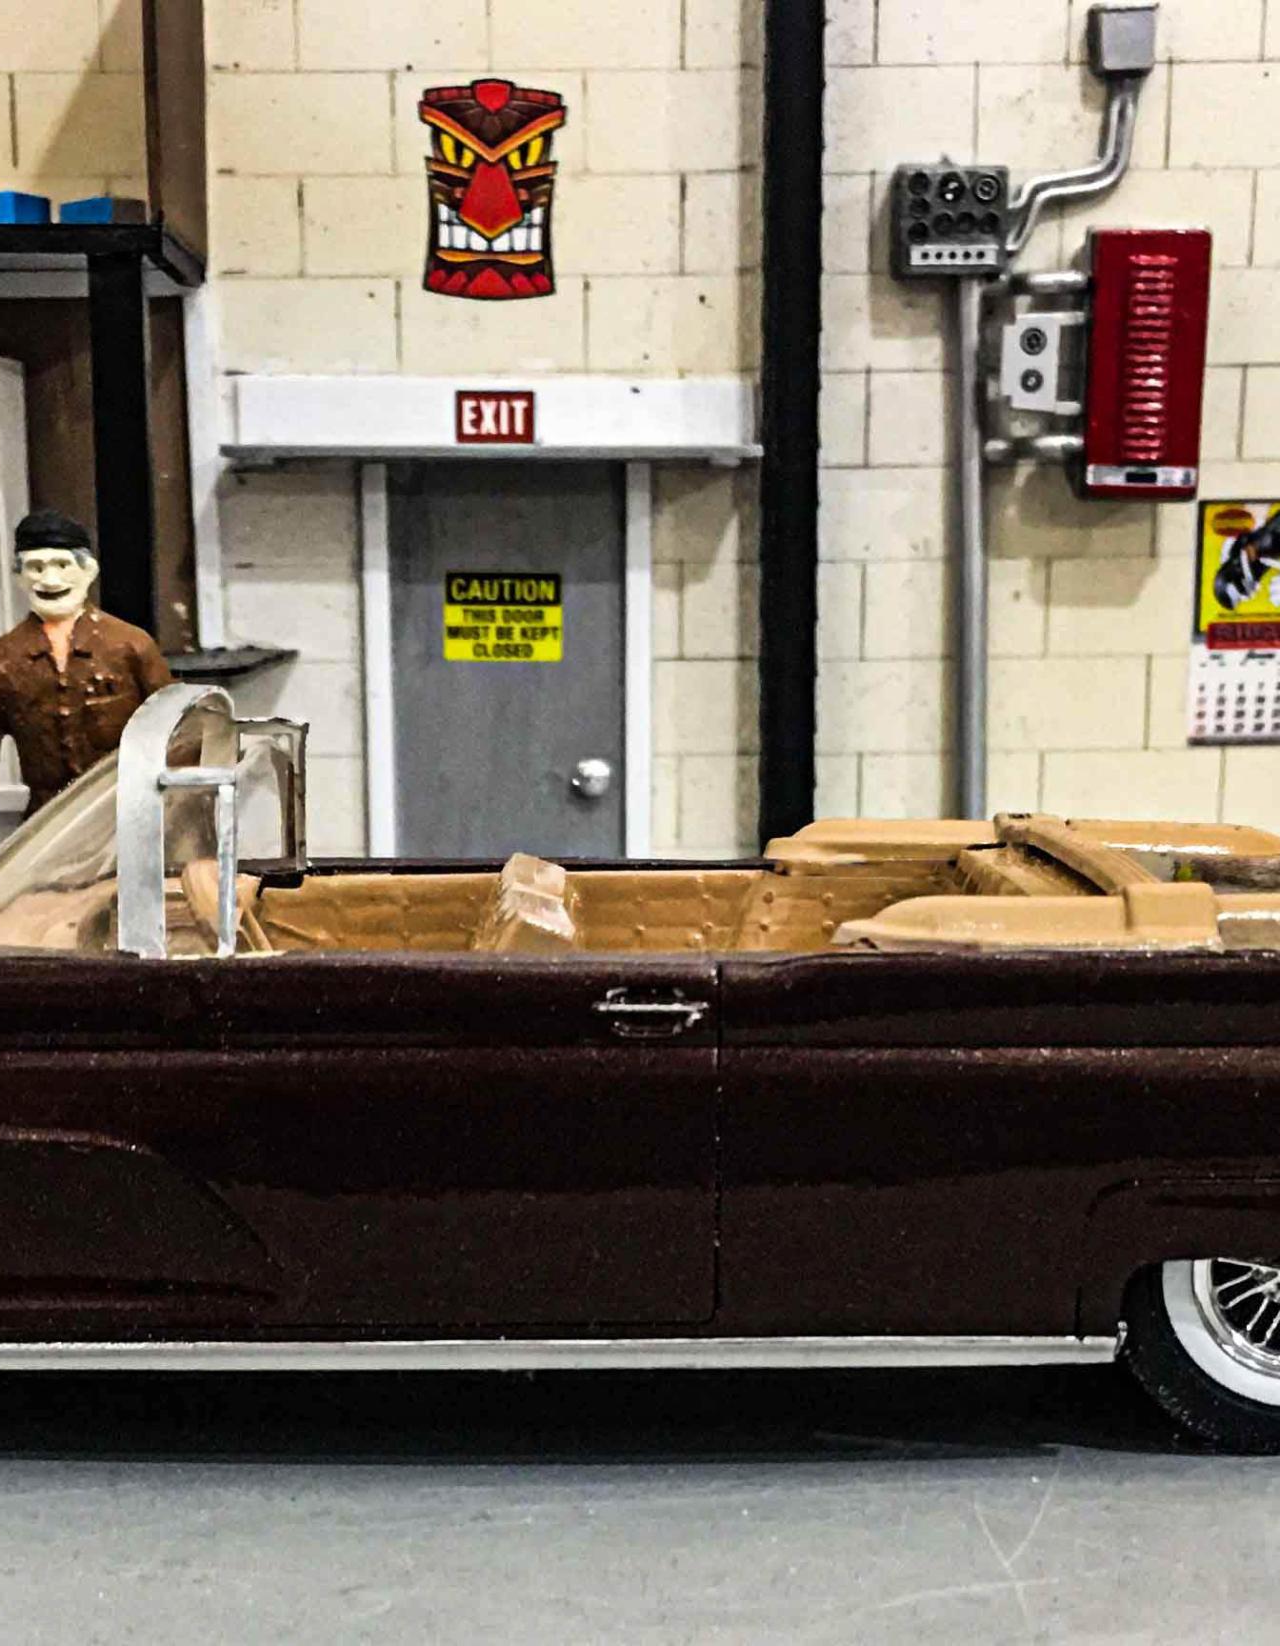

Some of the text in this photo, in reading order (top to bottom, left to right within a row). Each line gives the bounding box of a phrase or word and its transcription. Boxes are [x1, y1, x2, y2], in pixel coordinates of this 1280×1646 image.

[461, 399, 529, 435] EXIT
[451, 578, 555, 601] CAUTION
[463, 608, 545, 623] THIS DOOR
[446, 625, 560, 640] MUST BE KEPT
[472, 643, 534, 659] CLOSED
